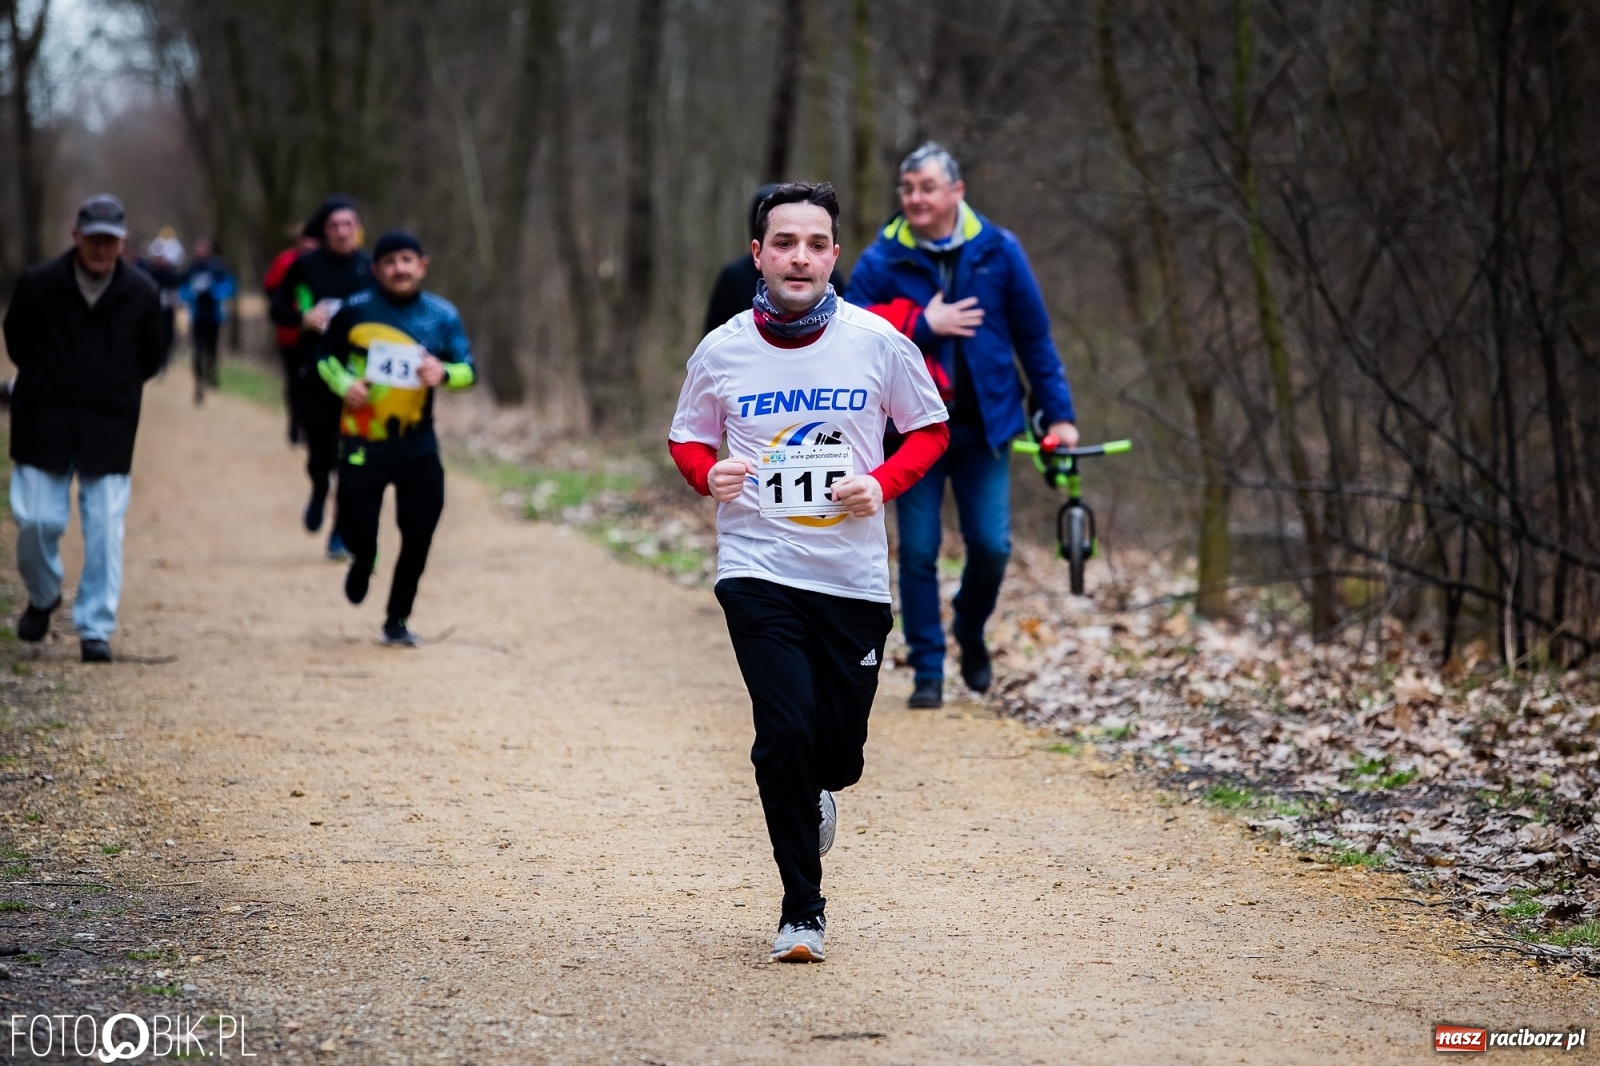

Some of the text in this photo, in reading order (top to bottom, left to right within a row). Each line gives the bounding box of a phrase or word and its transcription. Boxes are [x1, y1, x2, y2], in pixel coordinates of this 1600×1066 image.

[378, 358, 410, 379] 43
[738, 388, 868, 418] TENNECO
[790, 451, 849, 460] www.personalbest.pl
[765, 470, 847, 504] 115
